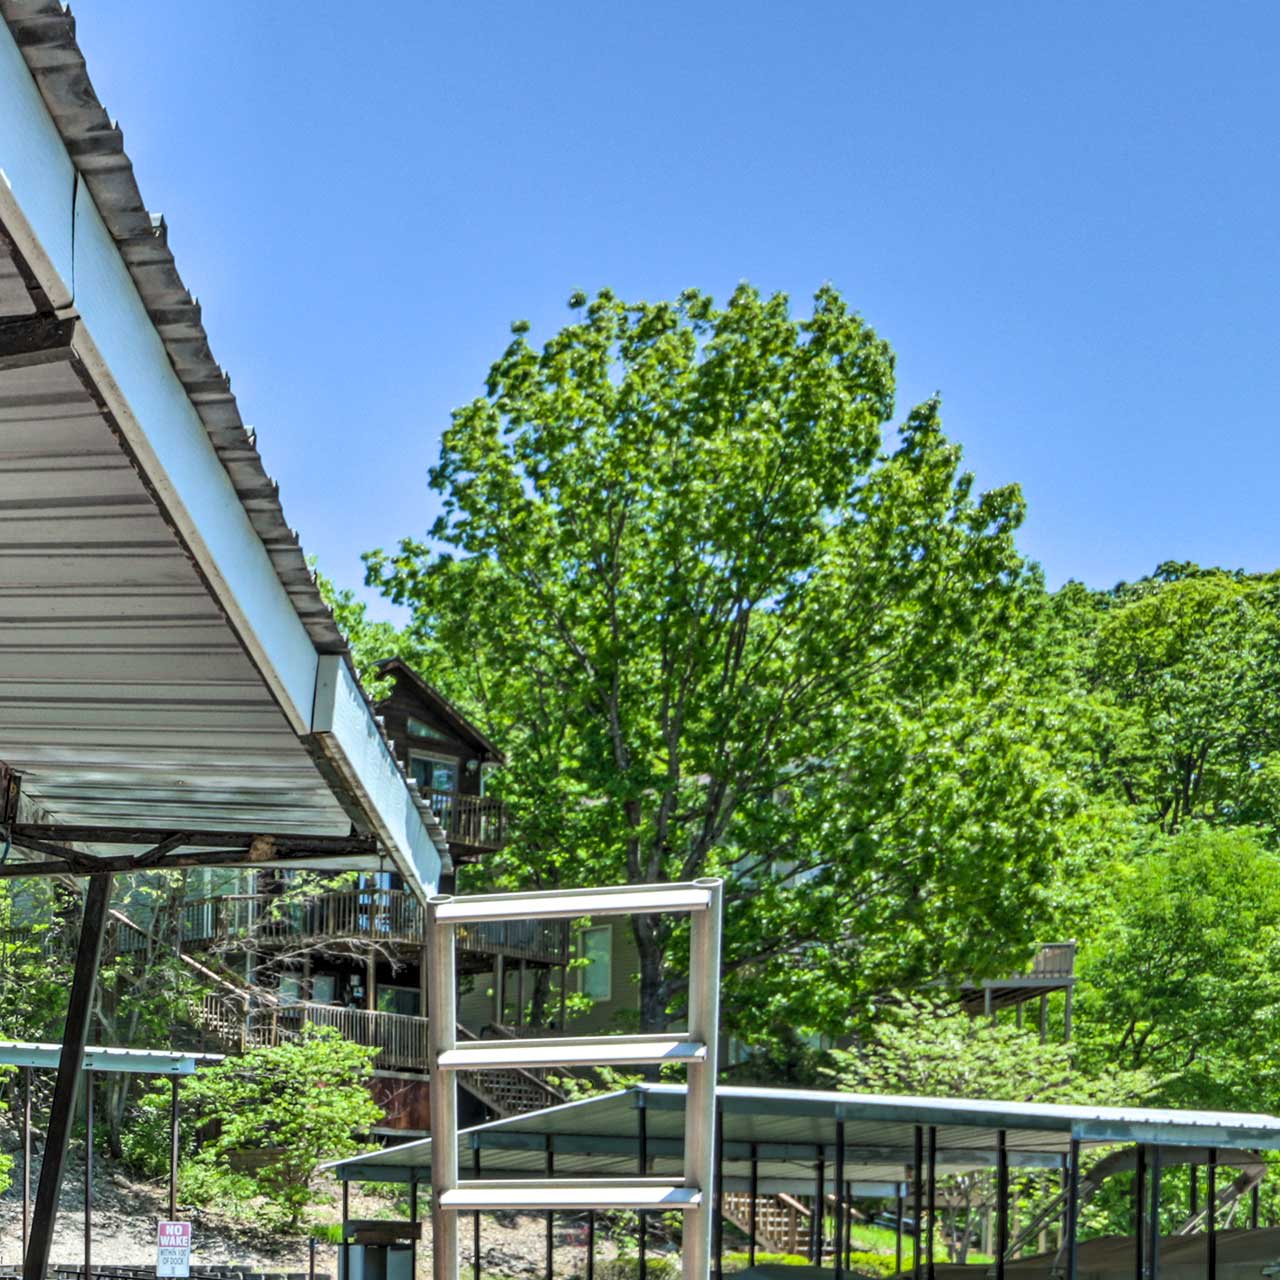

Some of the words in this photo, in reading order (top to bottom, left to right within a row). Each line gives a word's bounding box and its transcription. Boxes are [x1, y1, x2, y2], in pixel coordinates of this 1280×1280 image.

[166, 1224, 183, 1236] NO
[160, 1235, 189, 1246] WAKE
[160, 1248, 177, 1257] WITHIN
[162, 1256, 169, 1265] OF
[170, 1256, 184, 1265] DOCK
